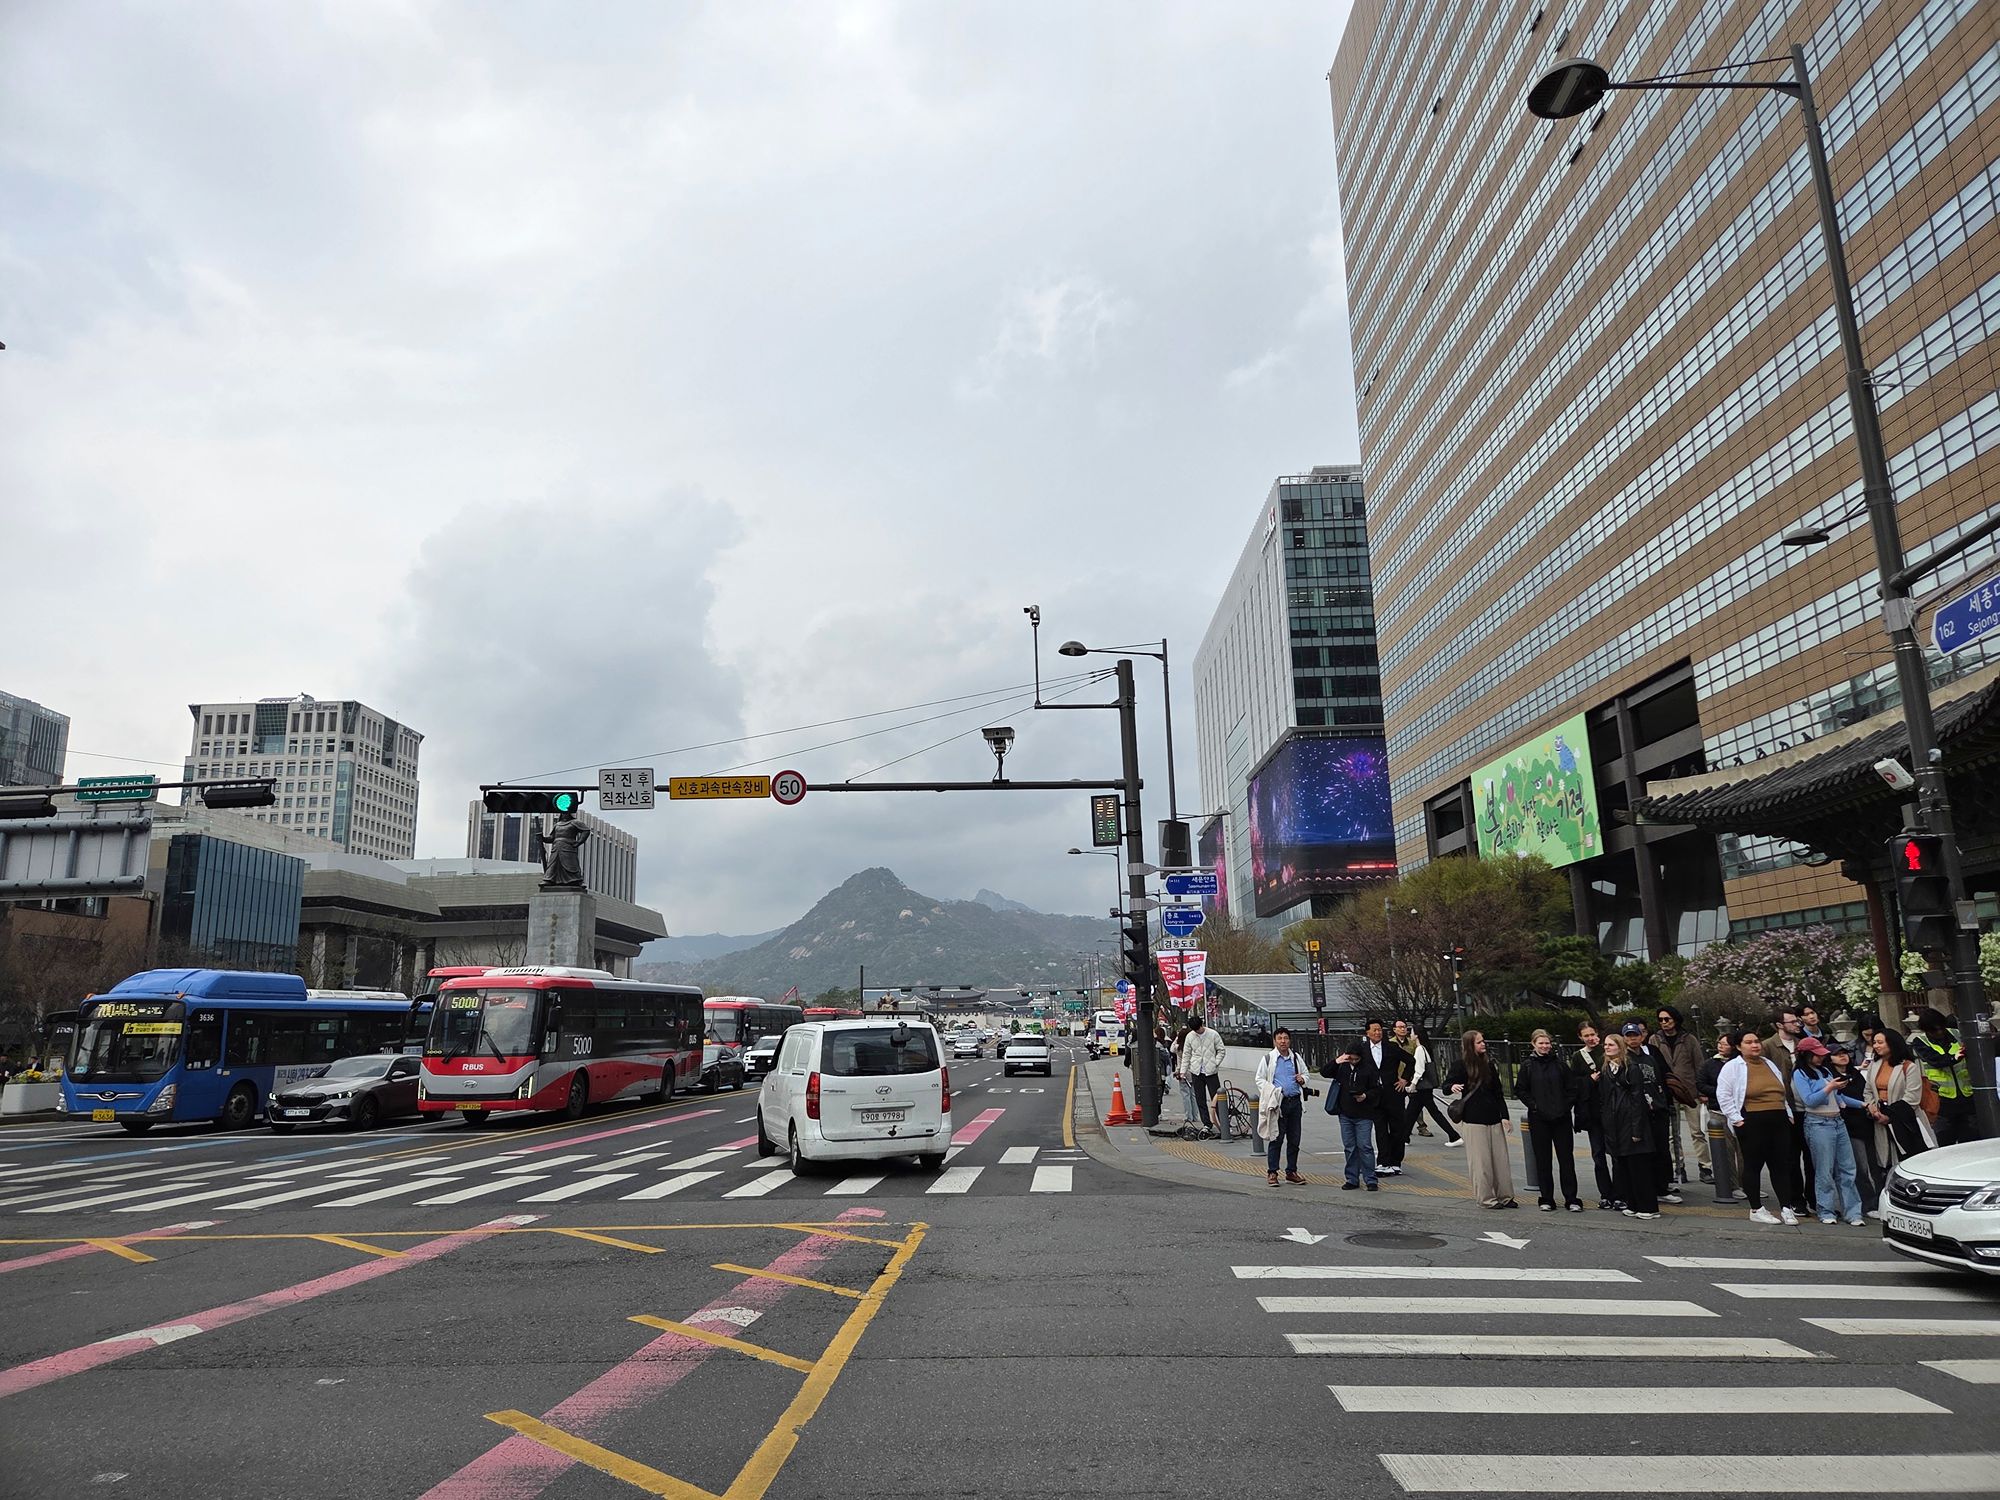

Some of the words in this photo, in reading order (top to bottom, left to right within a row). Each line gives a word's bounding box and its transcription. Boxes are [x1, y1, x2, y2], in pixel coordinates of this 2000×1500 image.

[1938, 620, 1956, 641] 162
[677, 781, 764, 795] 신호과속단속장비
[779, 779, 800, 796] 50
[603, 790, 652, 805] 직좌신호
[1557, 780, 1585, 828] 기적
[451, 997, 479, 1009] 5000
[573, 1037, 592, 1054] 5000
[689, 1035, 697, 1044] BUS
[883, 1111, 901, 1120] 9798
[1908, 1220, 1928, 1235] 8886
